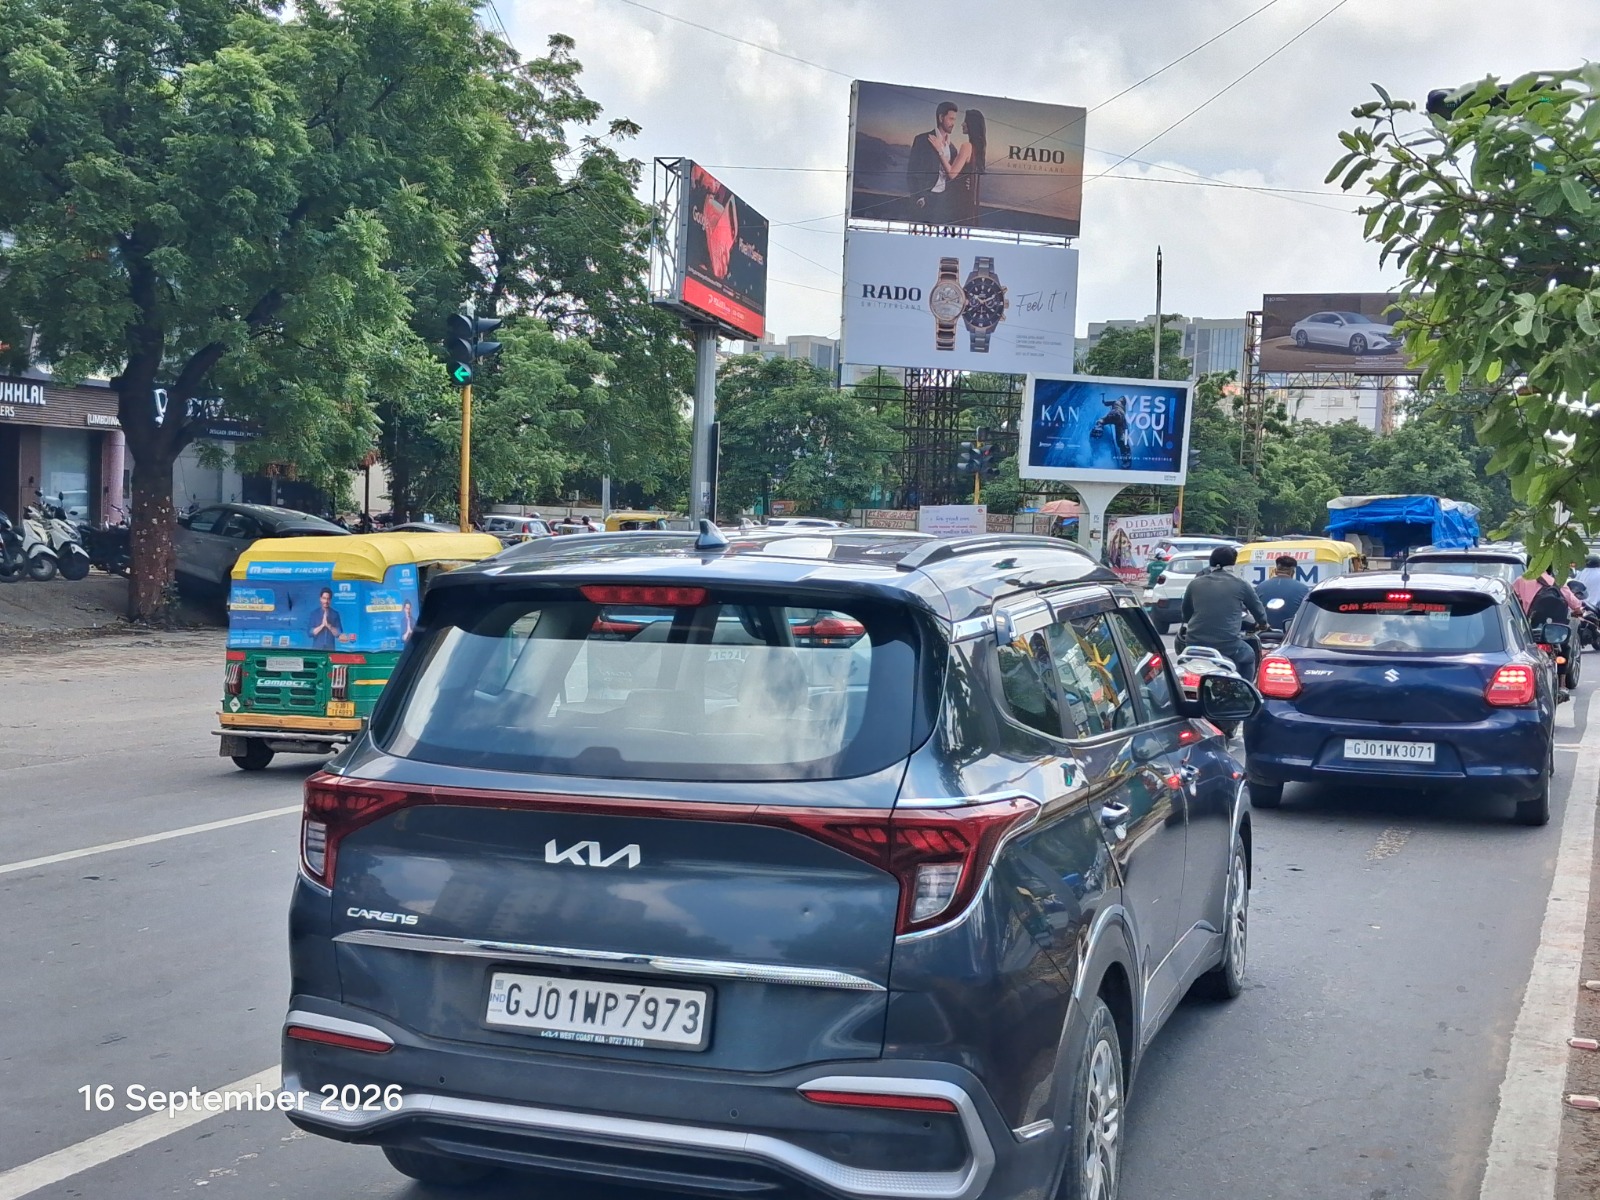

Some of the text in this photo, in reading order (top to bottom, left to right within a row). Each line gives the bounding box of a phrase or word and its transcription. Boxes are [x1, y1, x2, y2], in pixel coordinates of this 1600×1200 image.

[1008, 145, 1065, 164] RADO
[862, 283, 921, 302] RADO
[1041, 404, 1080, 423] KAN
[1124, 394, 1166, 414] YES
[1125, 412, 1165, 431] YOU
[1125, 518, 1172, 529] DIDAAR
[1353, 742, 1433, 759] GJ01WK3071
[544, 838, 641, 869] KIA
[345, 907, 419, 925] CARENS
[489, 992, 506, 1003] IND
[505, 983, 701, 1034] GJ01WP7973
[559, 1031, 575, 1040] WEST
[576, 1032, 594, 1042] COAST
